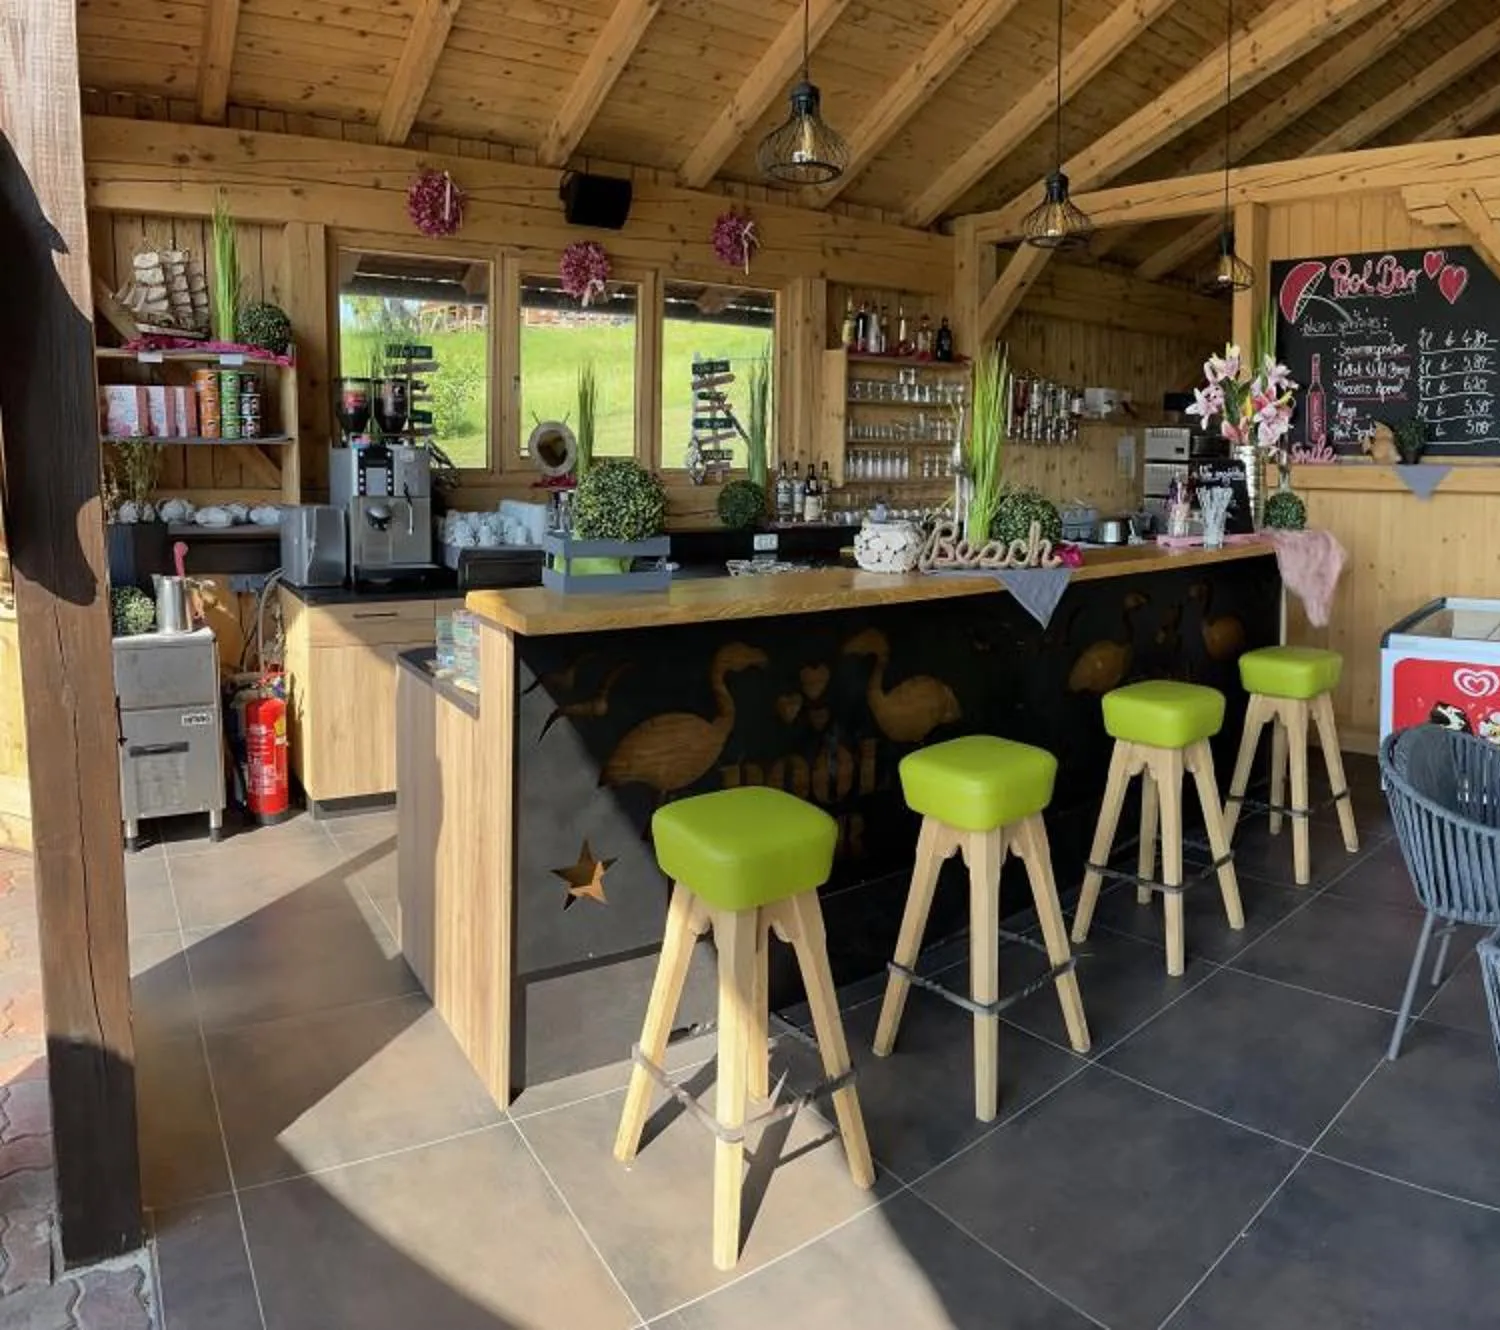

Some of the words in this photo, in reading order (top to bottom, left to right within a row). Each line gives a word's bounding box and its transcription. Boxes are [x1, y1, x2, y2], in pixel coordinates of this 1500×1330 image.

[1376, 255, 1422, 294] Bar
[1290, 433, 1338, 464] Smile
[919, 518, 1063, 571] Beach
